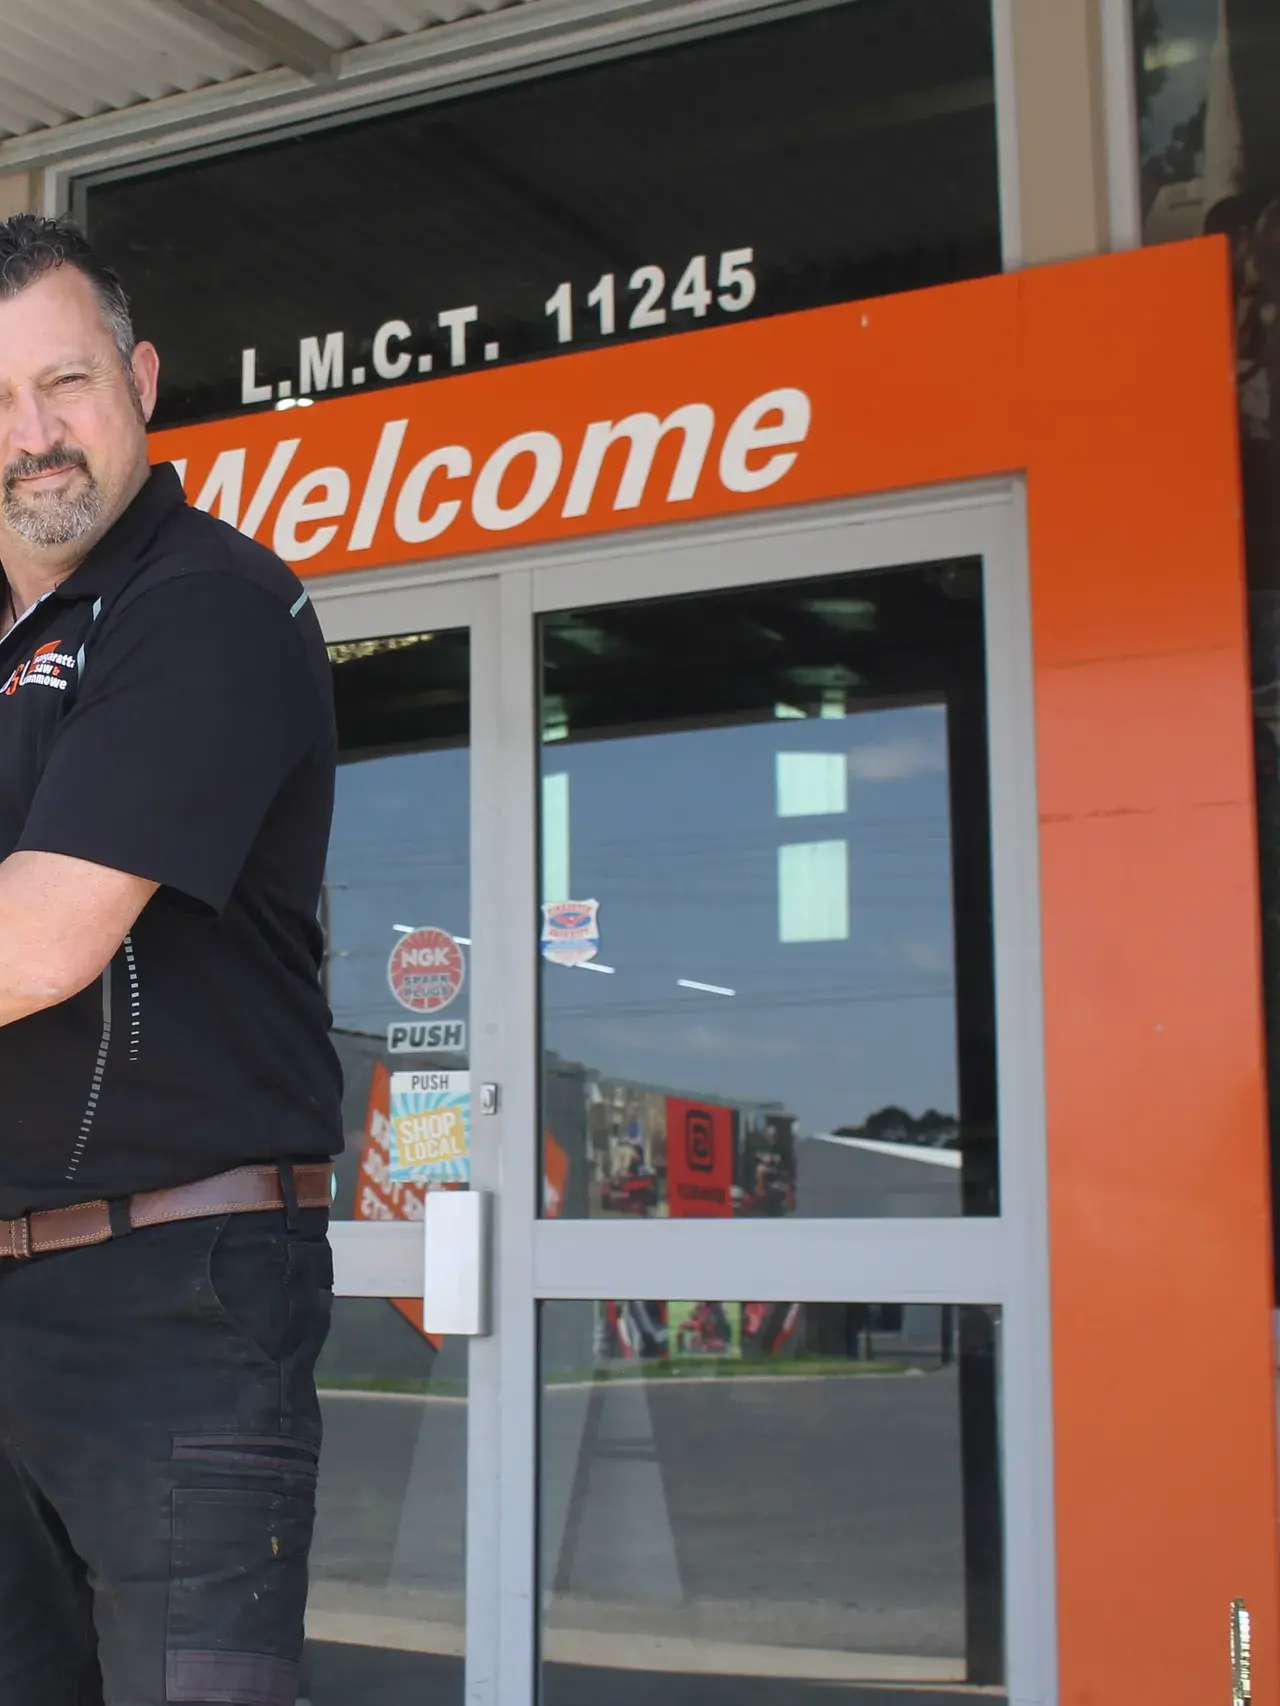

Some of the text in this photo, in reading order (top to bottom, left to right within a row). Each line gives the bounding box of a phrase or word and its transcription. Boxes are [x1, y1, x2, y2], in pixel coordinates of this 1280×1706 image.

[241, 247, 757, 404] L.M.C.T. 11245
[174, 387, 812, 562] Welcome
[401, 946, 451, 969] NGK
[391, 1024, 462, 1049] PUSH
[411, 1074, 450, 1090] PUSH
[399, 1111, 455, 1143] SHOP
[404, 1136, 462, 1162] LOCAL
